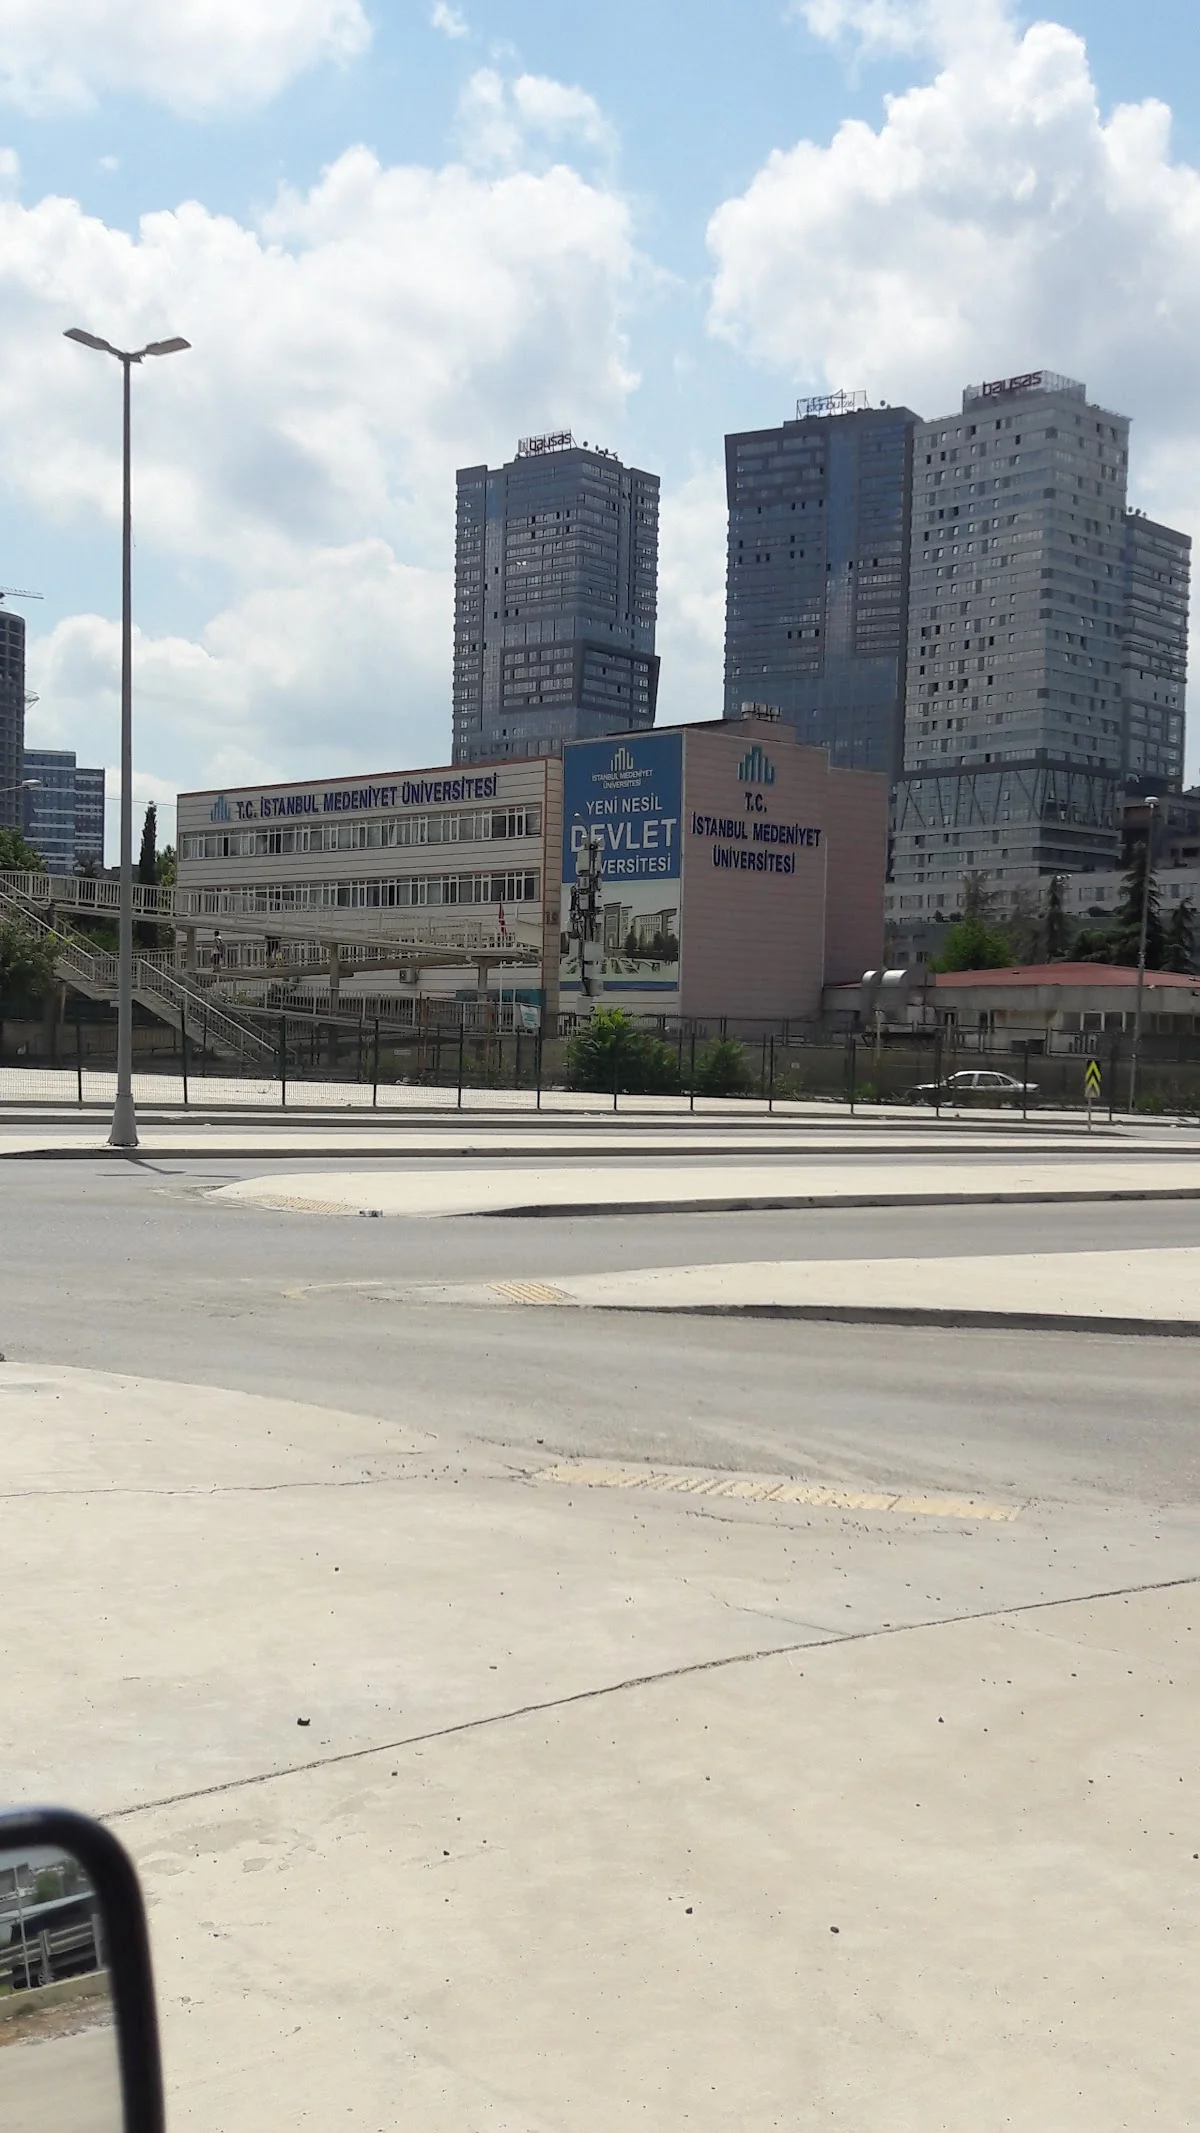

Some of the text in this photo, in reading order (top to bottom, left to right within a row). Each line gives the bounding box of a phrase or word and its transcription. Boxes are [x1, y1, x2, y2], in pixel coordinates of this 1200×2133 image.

[591, 769, 653, 782] İSTANBUL MEDENİYET
[236, 771, 498, 820] T.C. İSTANBUL MEDENİYET ÜNİVERSİTESİ
[586, 792, 663, 815] YENİ NESİL
[744, 791, 767, 812] T.C.
[571, 818, 677, 852] DEVLET
[691, 811, 821, 847] İSTANBUL MEDENİYET
[575, 852, 671, 875] VERSİTESİ
[712, 844, 796, 874] ÜNİVERSİTESİ
